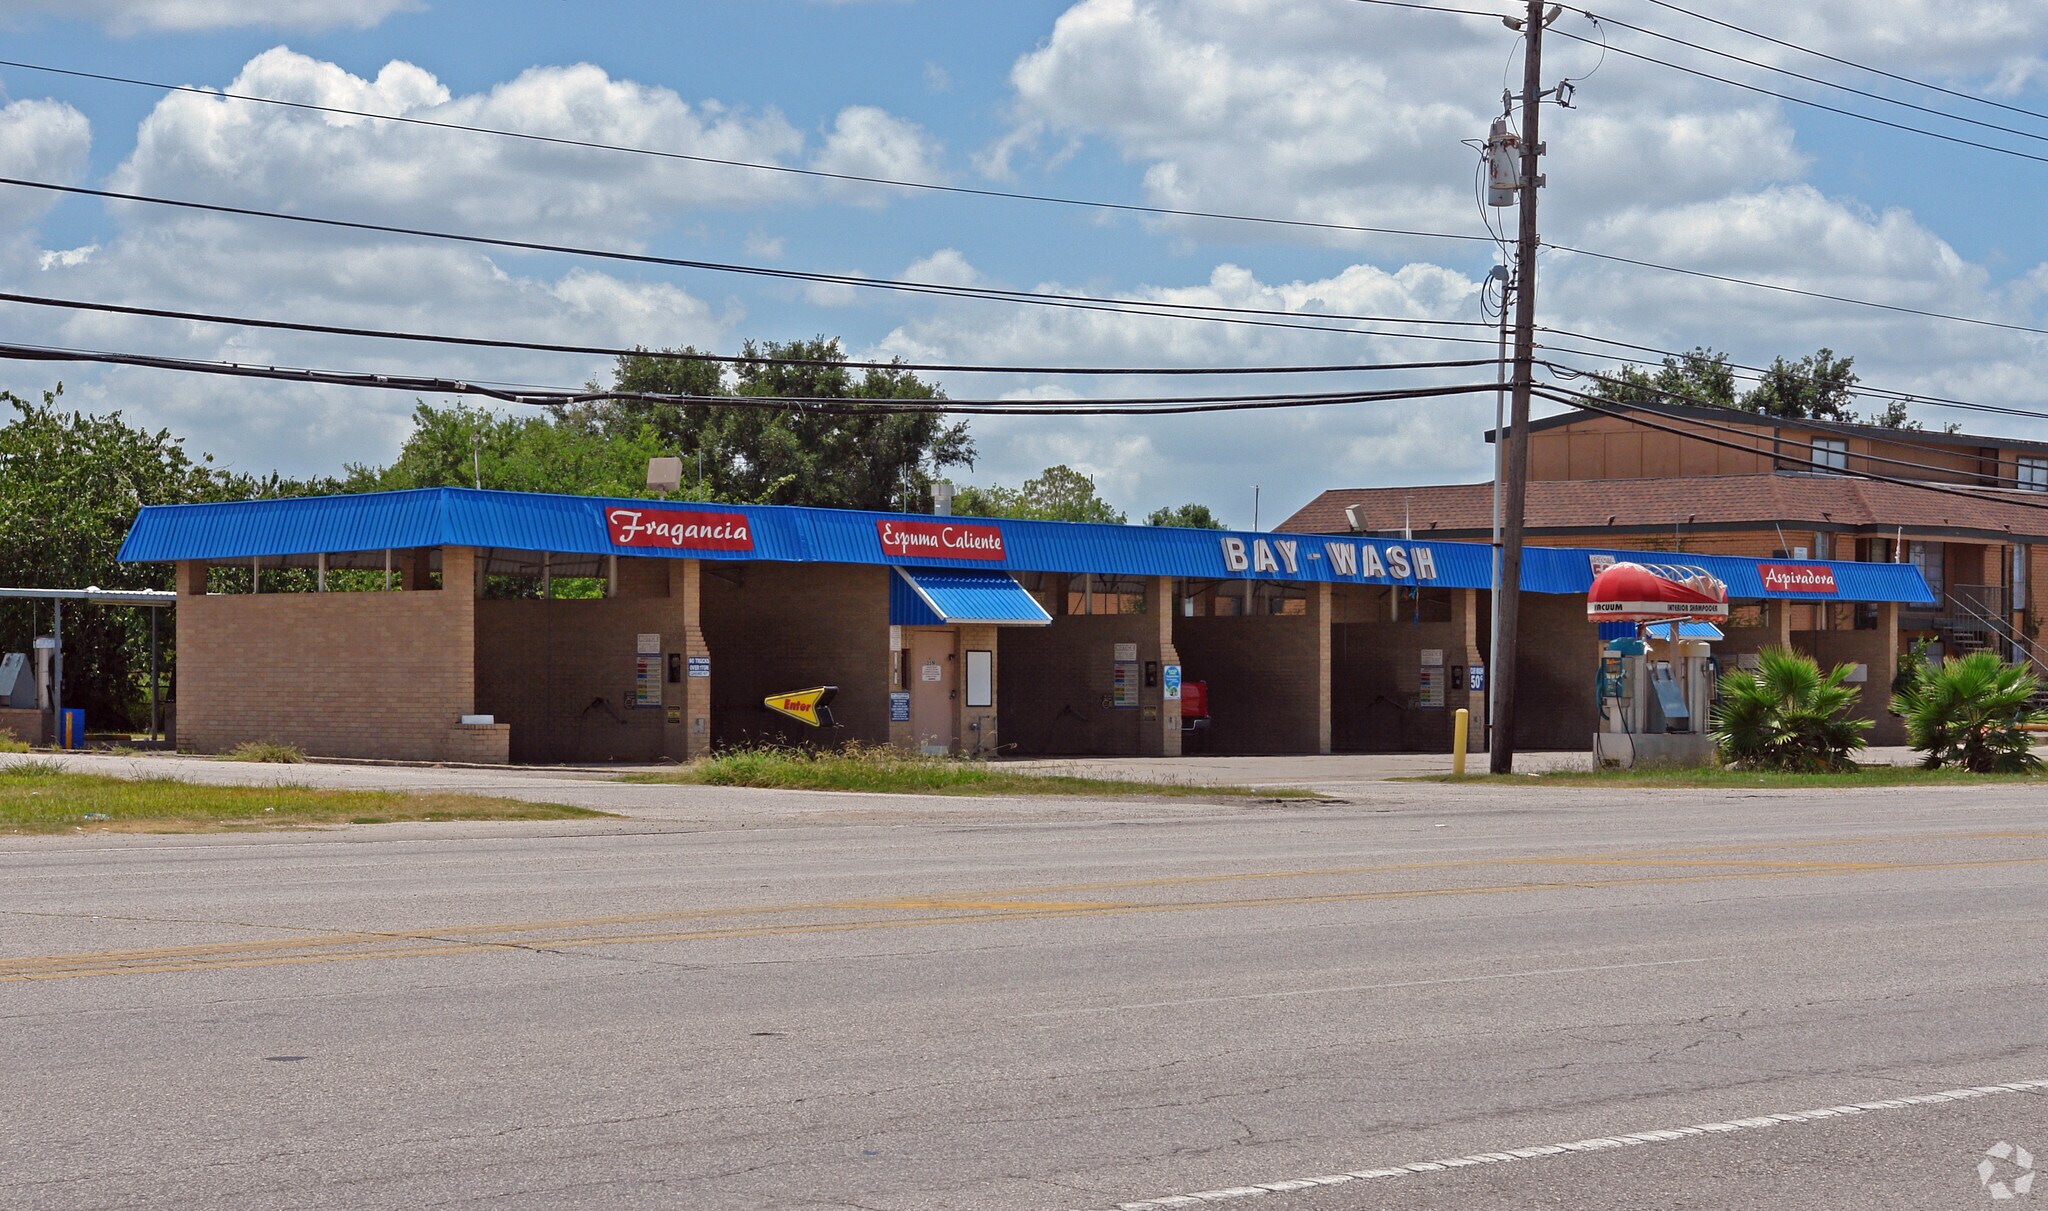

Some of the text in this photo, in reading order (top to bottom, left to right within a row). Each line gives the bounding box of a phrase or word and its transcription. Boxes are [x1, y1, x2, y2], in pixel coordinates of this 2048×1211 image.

[610, 510, 747, 545] Fragancia
[883, 523, 1002, 554] Espuma Caliente
[1220, 537, 1298, 573] BAY
[1325, 542, 1437, 580] WASH
[1765, 568, 1834, 589] Aspiradora
[1667, 604, 1689, 612] INTERIOR
[783, 699, 811, 712] Enter
